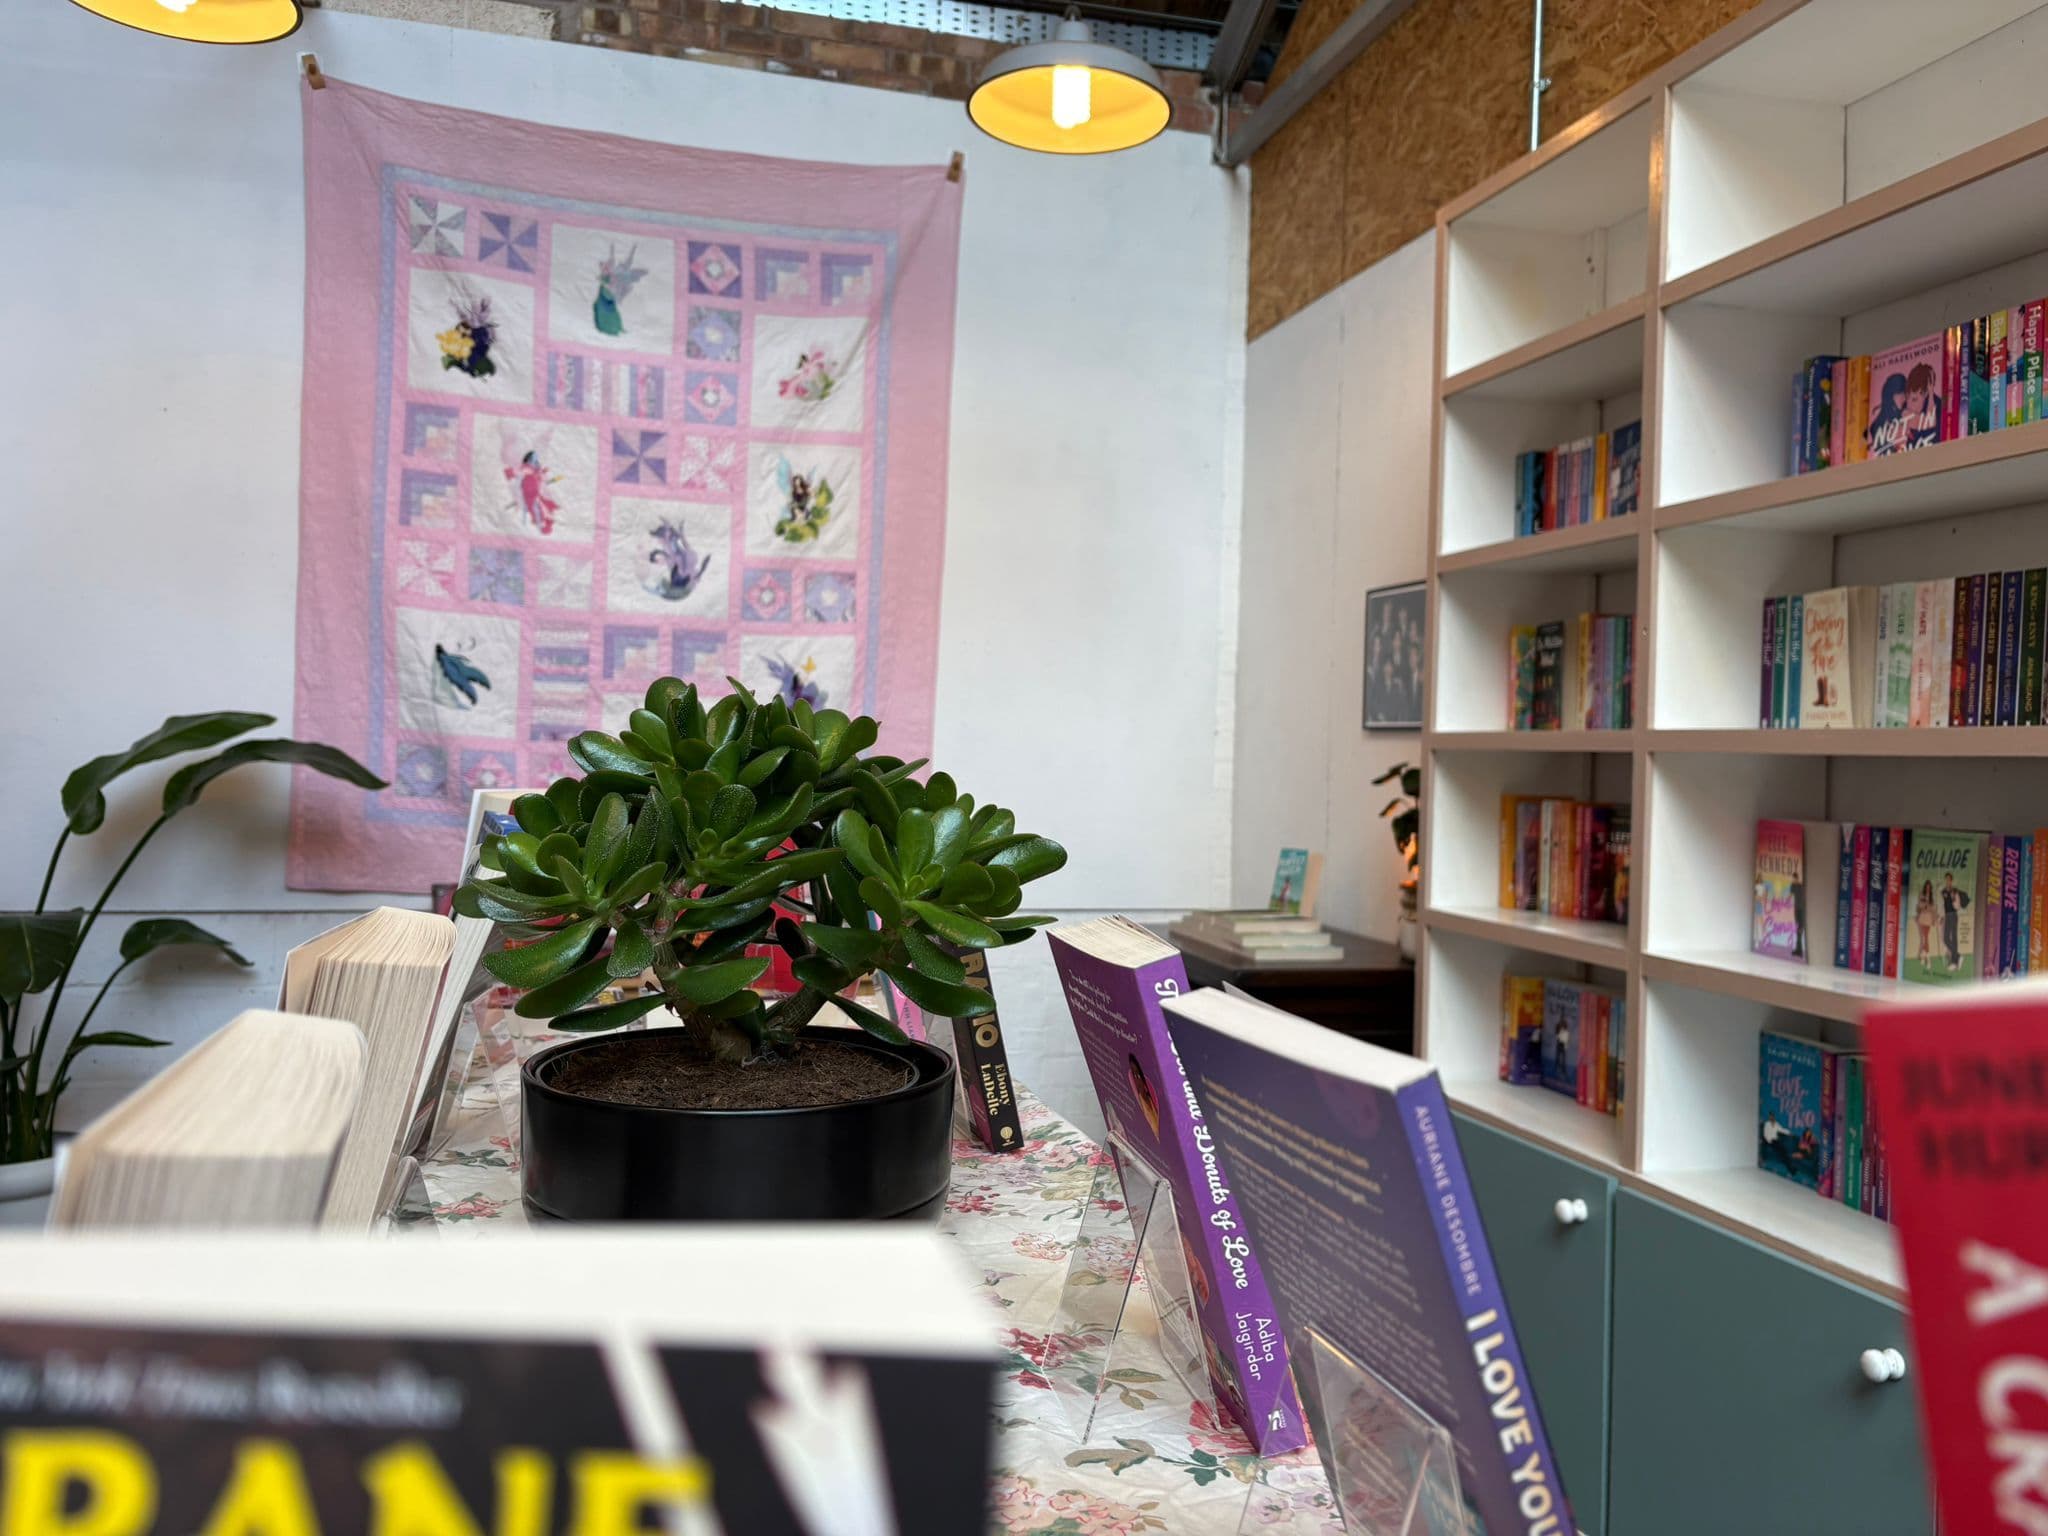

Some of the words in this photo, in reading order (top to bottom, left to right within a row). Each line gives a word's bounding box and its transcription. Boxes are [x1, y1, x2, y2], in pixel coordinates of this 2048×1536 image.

[1991, 317, 2005, 354] Book
[2025, 304, 2042, 354] Happy
[1873, 360, 1886, 371] ALI
[1888, 344, 1940, 366] HAZELWOOD
[1991, 355, 2004, 402] Lovers
[2026, 355, 2040, 395] Place
[1871, 413, 1915, 450] NOT
[1917, 406, 1937, 432] IN
[1916, 848, 1971, 869] COLLIDE
[1987, 845, 2002, 905] SPIRAL
[2003, 847, 2019, 912] REVOLVE
[981, 1063, 1000, 1116] LaDelle
[995, 1063, 1011, 1106] Ebony
[1193, 1124, 1228, 1206] Donuts
[1413, 1104, 1452, 1190] AURIANE
[1210, 1209, 1237, 1232] of
[1222, 1235, 1249, 1290] Love
[1440, 1194, 1483, 1297] DESOMBRE
[1255, 1316, 1278, 1364] Adiba
[1466, 1308, 1498, 1332] I
[1235, 1312, 1262, 1382] Jaigirdar
[1474, 1332, 1534, 1454] LOVE
